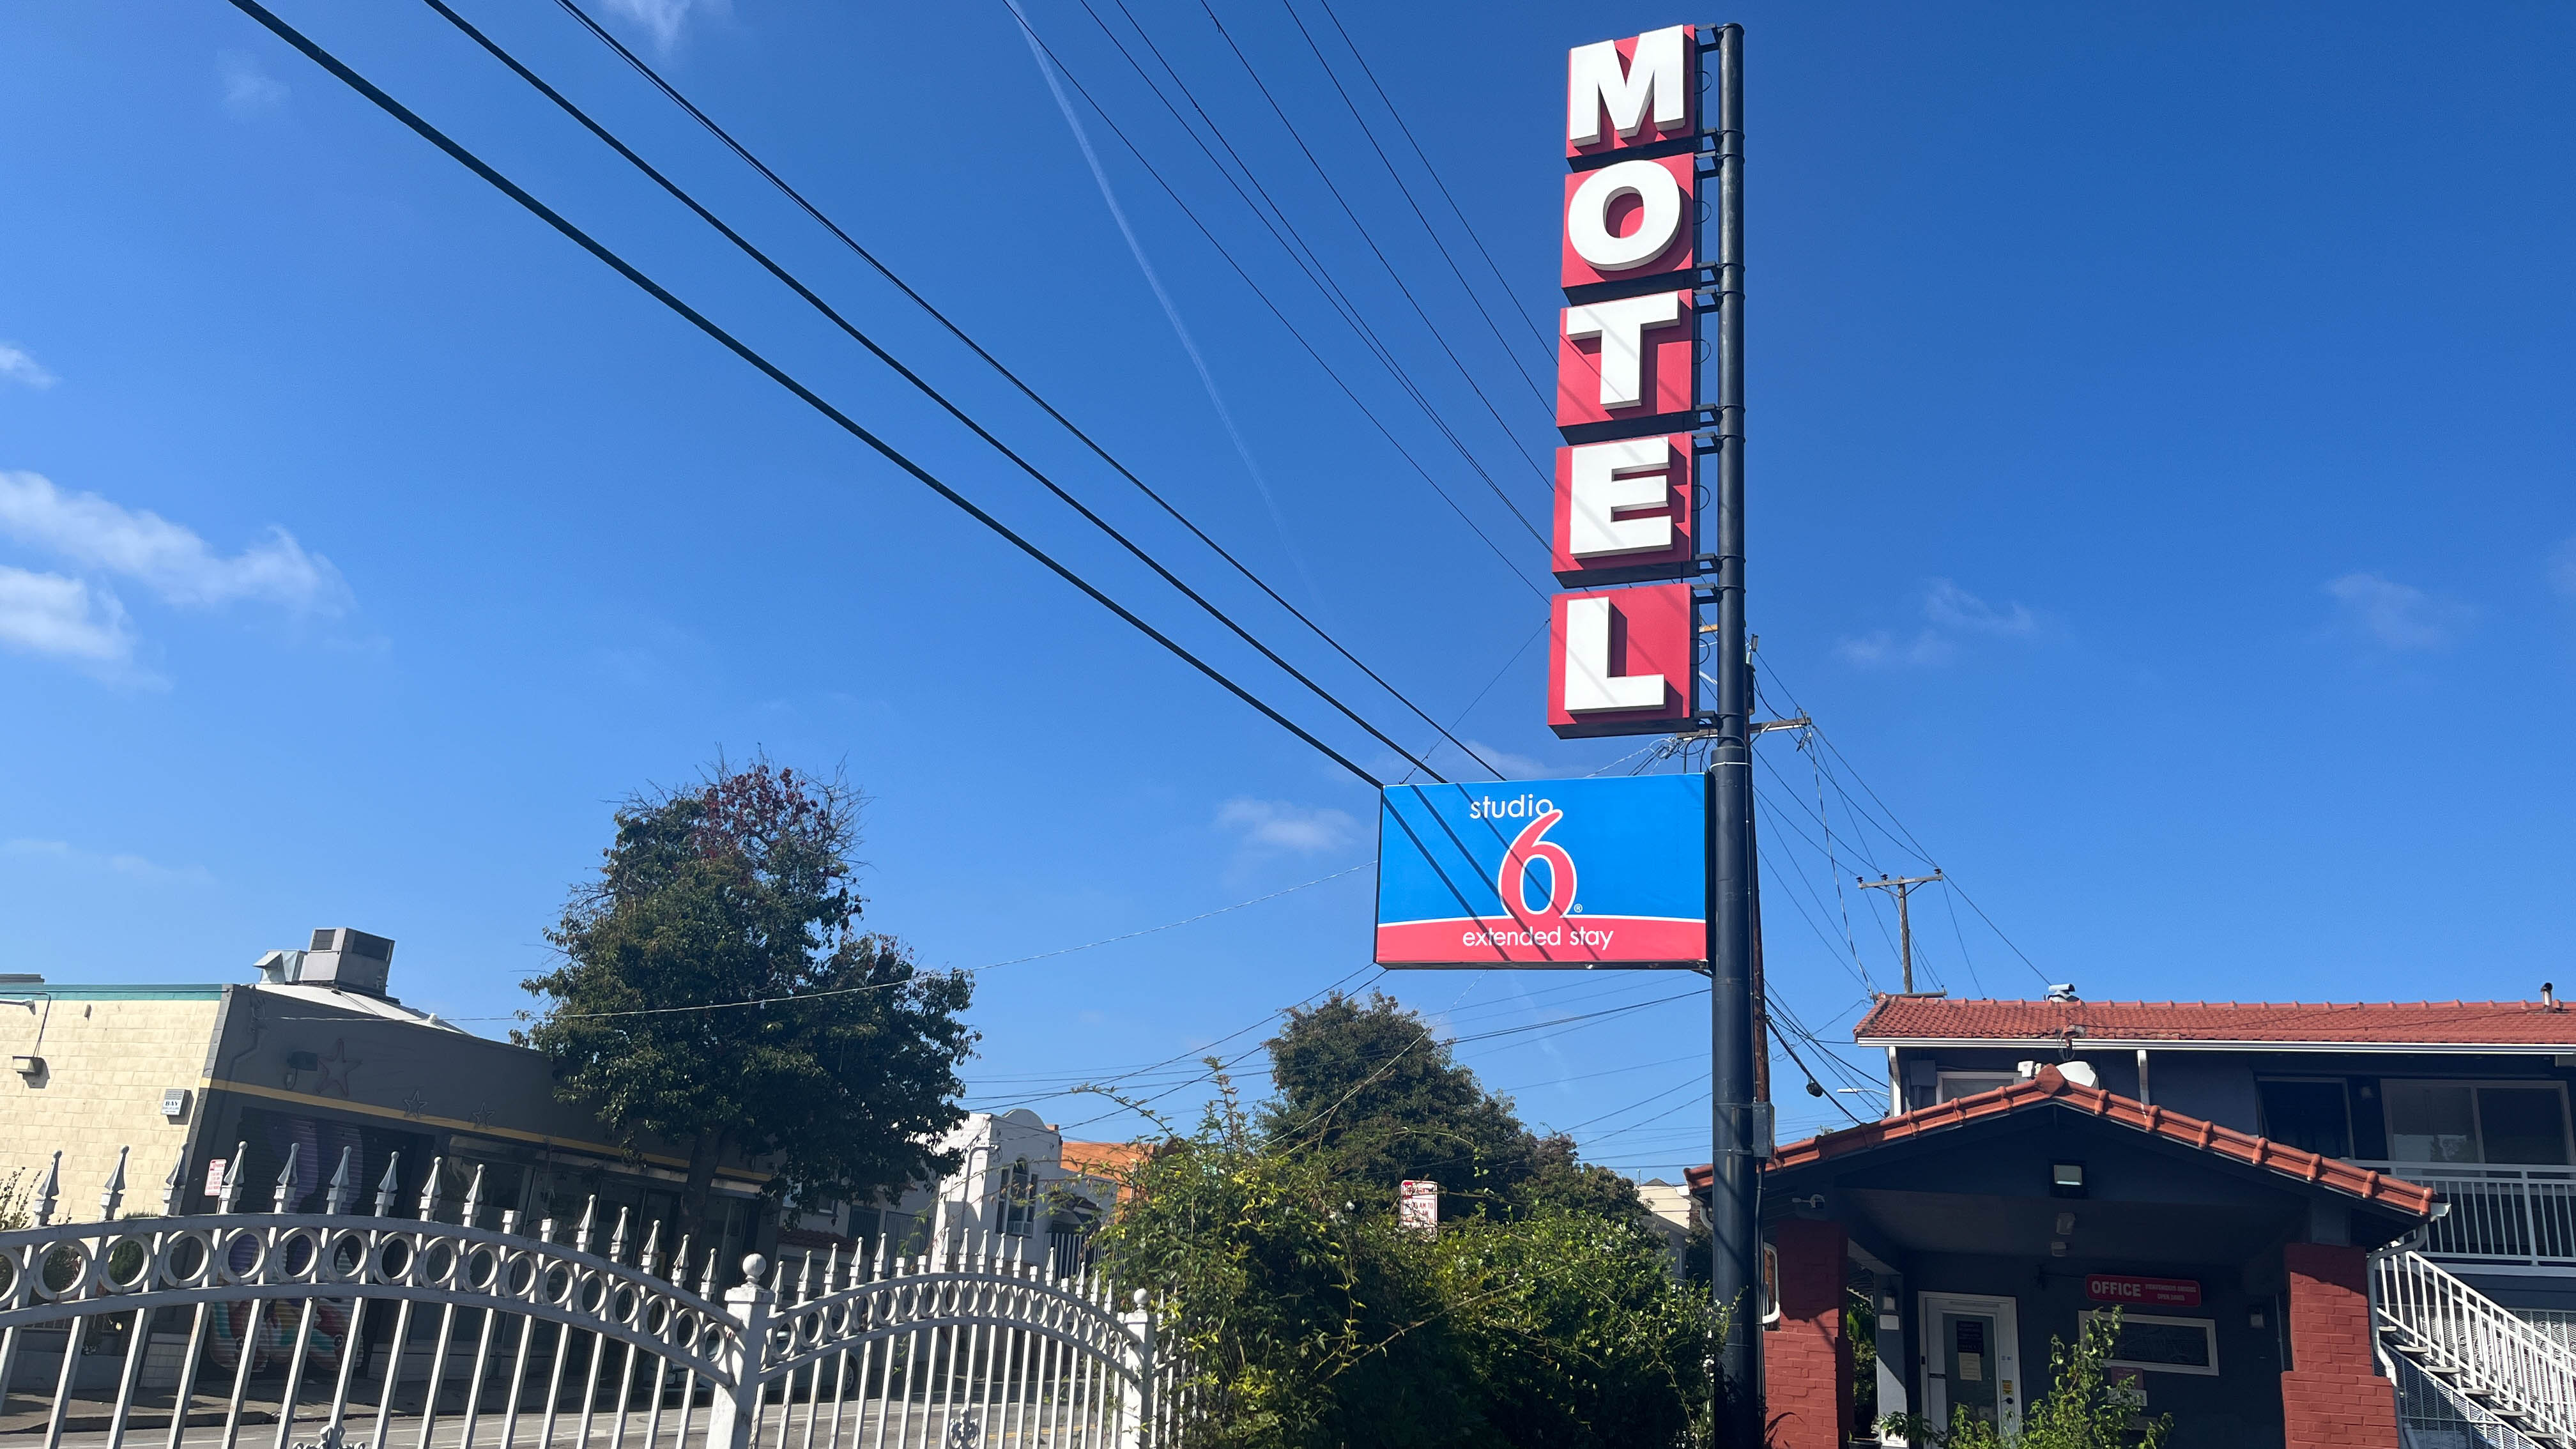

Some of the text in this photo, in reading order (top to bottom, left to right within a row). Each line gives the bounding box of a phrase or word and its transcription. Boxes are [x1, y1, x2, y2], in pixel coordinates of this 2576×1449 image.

[1565, 24, 1686, 714] MOTEL
[1469, 793, 1554, 818] studio
[1498, 809, 1577, 918] 6
[1462, 926, 1614, 951] extended stay
[2092, 1280, 2142, 1298] OFFICE
